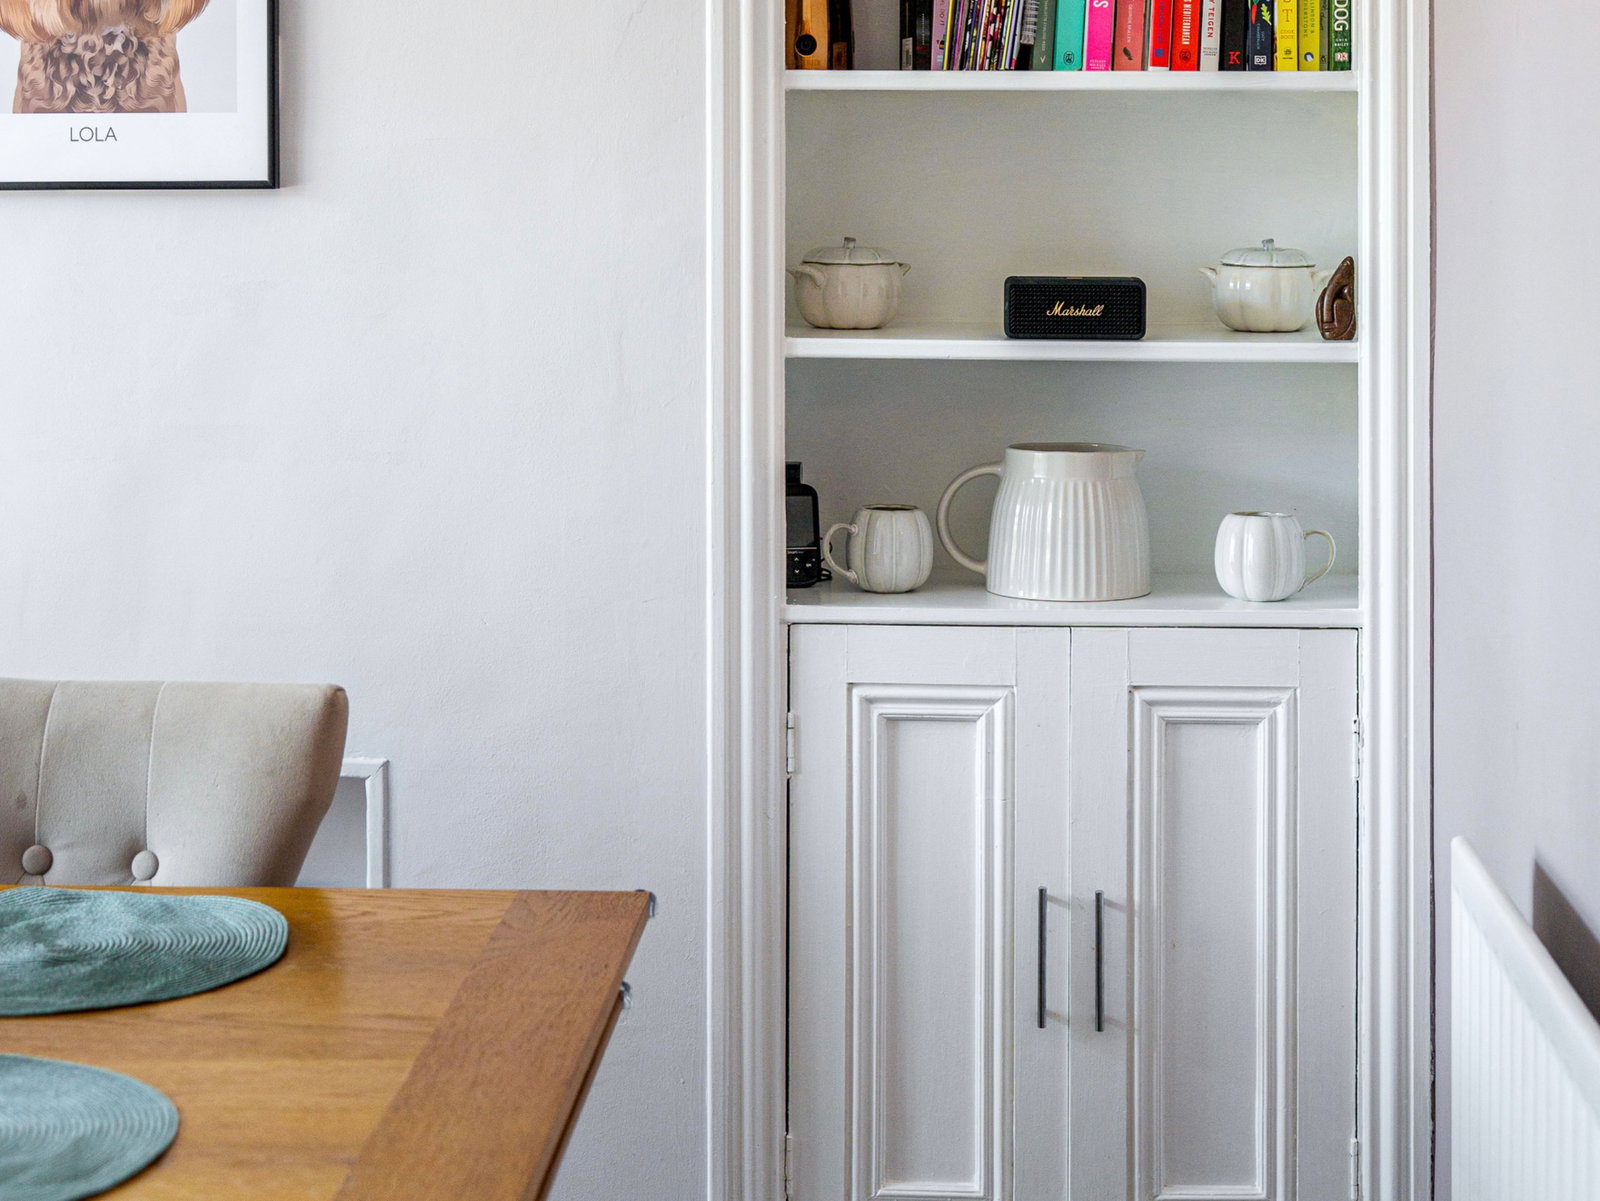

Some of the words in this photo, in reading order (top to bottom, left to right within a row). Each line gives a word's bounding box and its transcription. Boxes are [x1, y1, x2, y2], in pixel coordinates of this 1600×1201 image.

[1182, 4, 1192, 45] MEDITERRANEAN
[1207, 7, 1215, 38] TEIGEN
[70, 126, 118, 141] LOLA
[1046, 300, 1104, 316] Marshall
